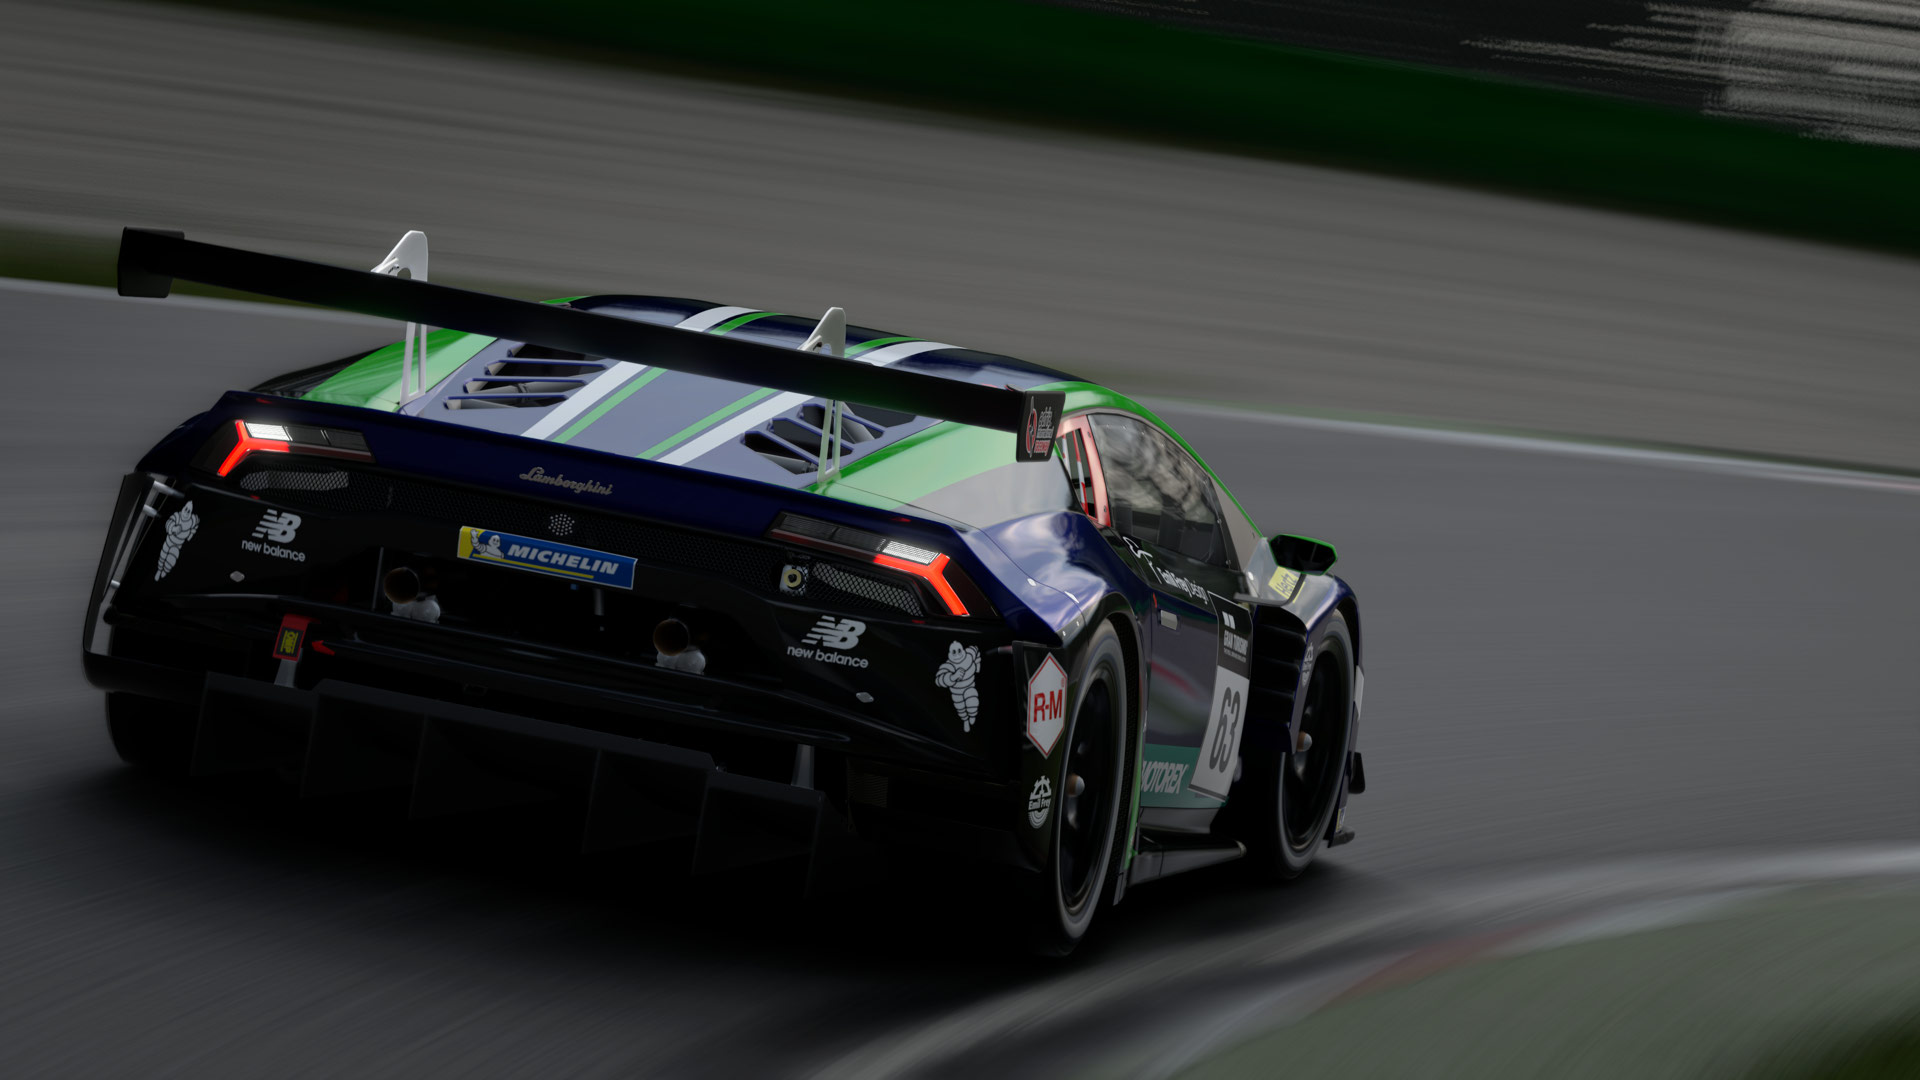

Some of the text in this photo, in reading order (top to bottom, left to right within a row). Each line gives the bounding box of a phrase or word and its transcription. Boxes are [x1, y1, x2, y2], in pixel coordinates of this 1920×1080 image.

[518, 466, 613, 496] Lamborghini
[241, 539, 306, 563] new balance
[507, 543, 620, 575] MICHELIN
[787, 645, 869, 669] new balance
[1034, 689, 1063, 722] R-M
[1209, 686, 1241, 773] 63
